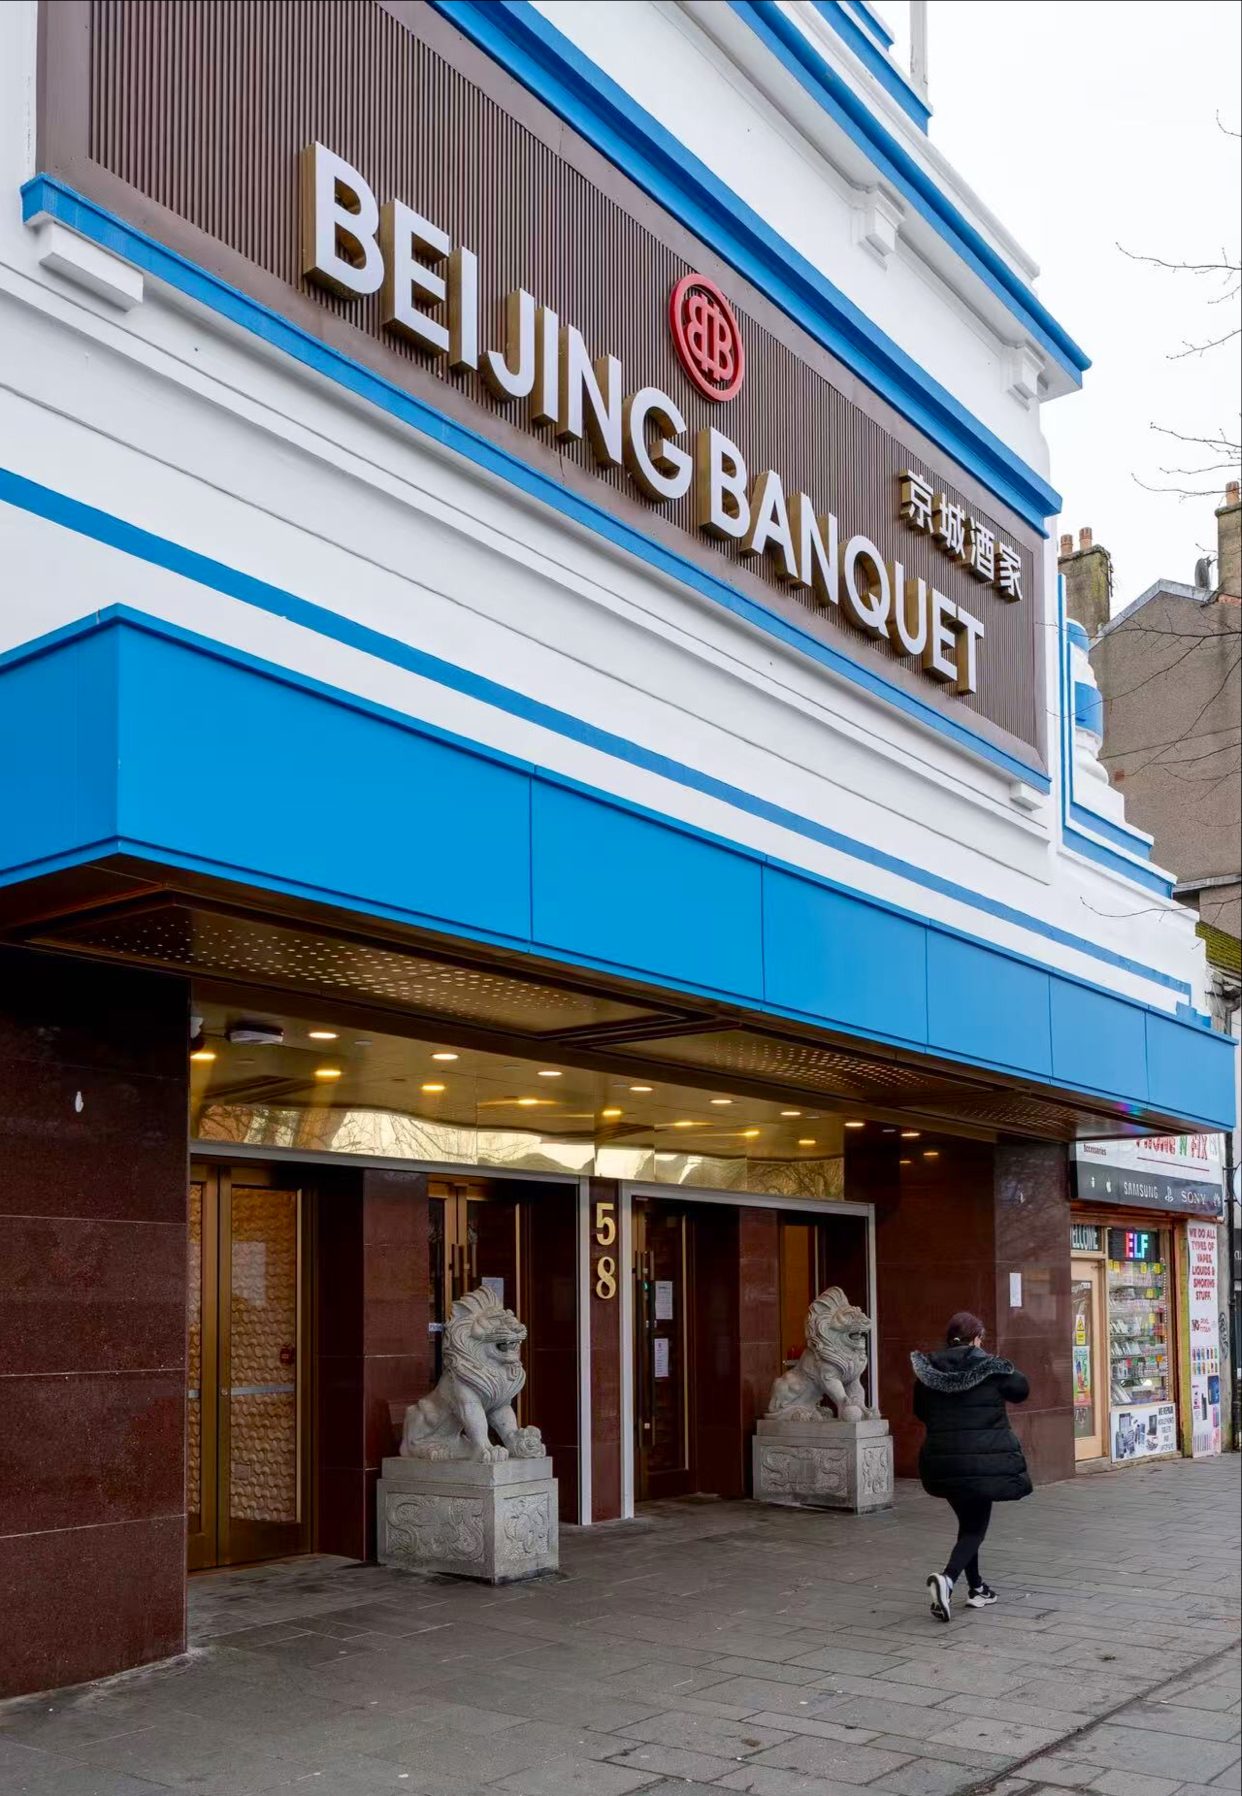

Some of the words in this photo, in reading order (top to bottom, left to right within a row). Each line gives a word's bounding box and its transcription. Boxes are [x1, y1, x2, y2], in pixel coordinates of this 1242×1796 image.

[304, 142, 692, 502] BEIJING
[702, 427, 985, 693] BANQUET
[902, 470, 1023, 601] 京城酒家
[1124, 1181, 1159, 1199] SAMSUNG
[1181, 1190, 1206, 1205] SONY
[1070, 1225, 1099, 1250] ELCOME
[1125, 1232, 1149, 1259] ELF
[1198, 1229, 1205, 1239] DO
[1207, 1229, 1216, 1239] ALL
[1208, 1241, 1215, 1251] OF
